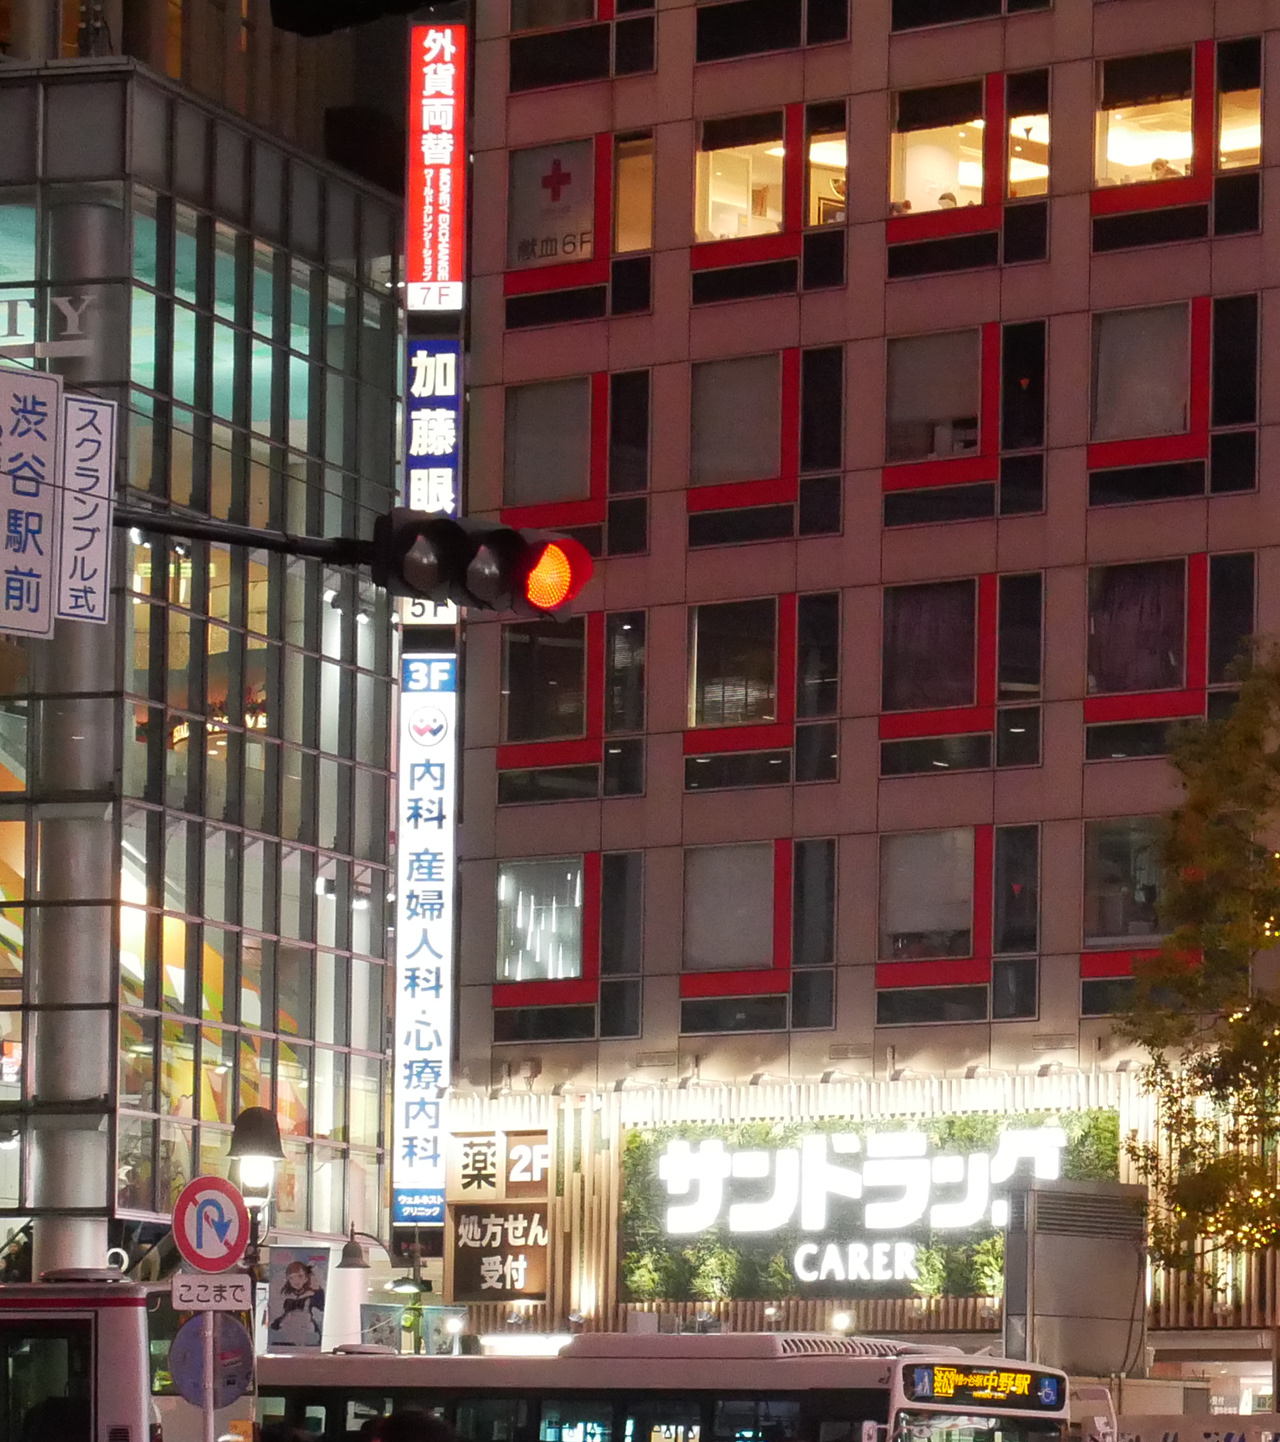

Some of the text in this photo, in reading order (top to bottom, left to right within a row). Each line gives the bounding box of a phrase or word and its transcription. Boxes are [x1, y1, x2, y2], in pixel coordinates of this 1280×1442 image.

[421, 29, 456, 165] 外貨両替
[437, 169, 451, 281] MONEY EXCHANGE
[420, 287, 451, 306] 7F
[409, 350, 457, 514] 加藤眼
[4, 393, 48, 614] 渋谷駅前
[69, 408, 102, 613] スクランブル式
[408, 662, 450, 690] 3F
[406, 758, 446, 829] 内科
[461, 1140, 497, 1190] 薬
[509, 1144, 549, 1182] 2F
[458, 1214, 549, 1248] 処方せん
[480, 1254, 529, 1289] 受付
[794, 1241, 919, 1282] CARER
[178, 1285, 246, 1303] ここまで
[983, 1371, 1031, 1395] 中野駅
